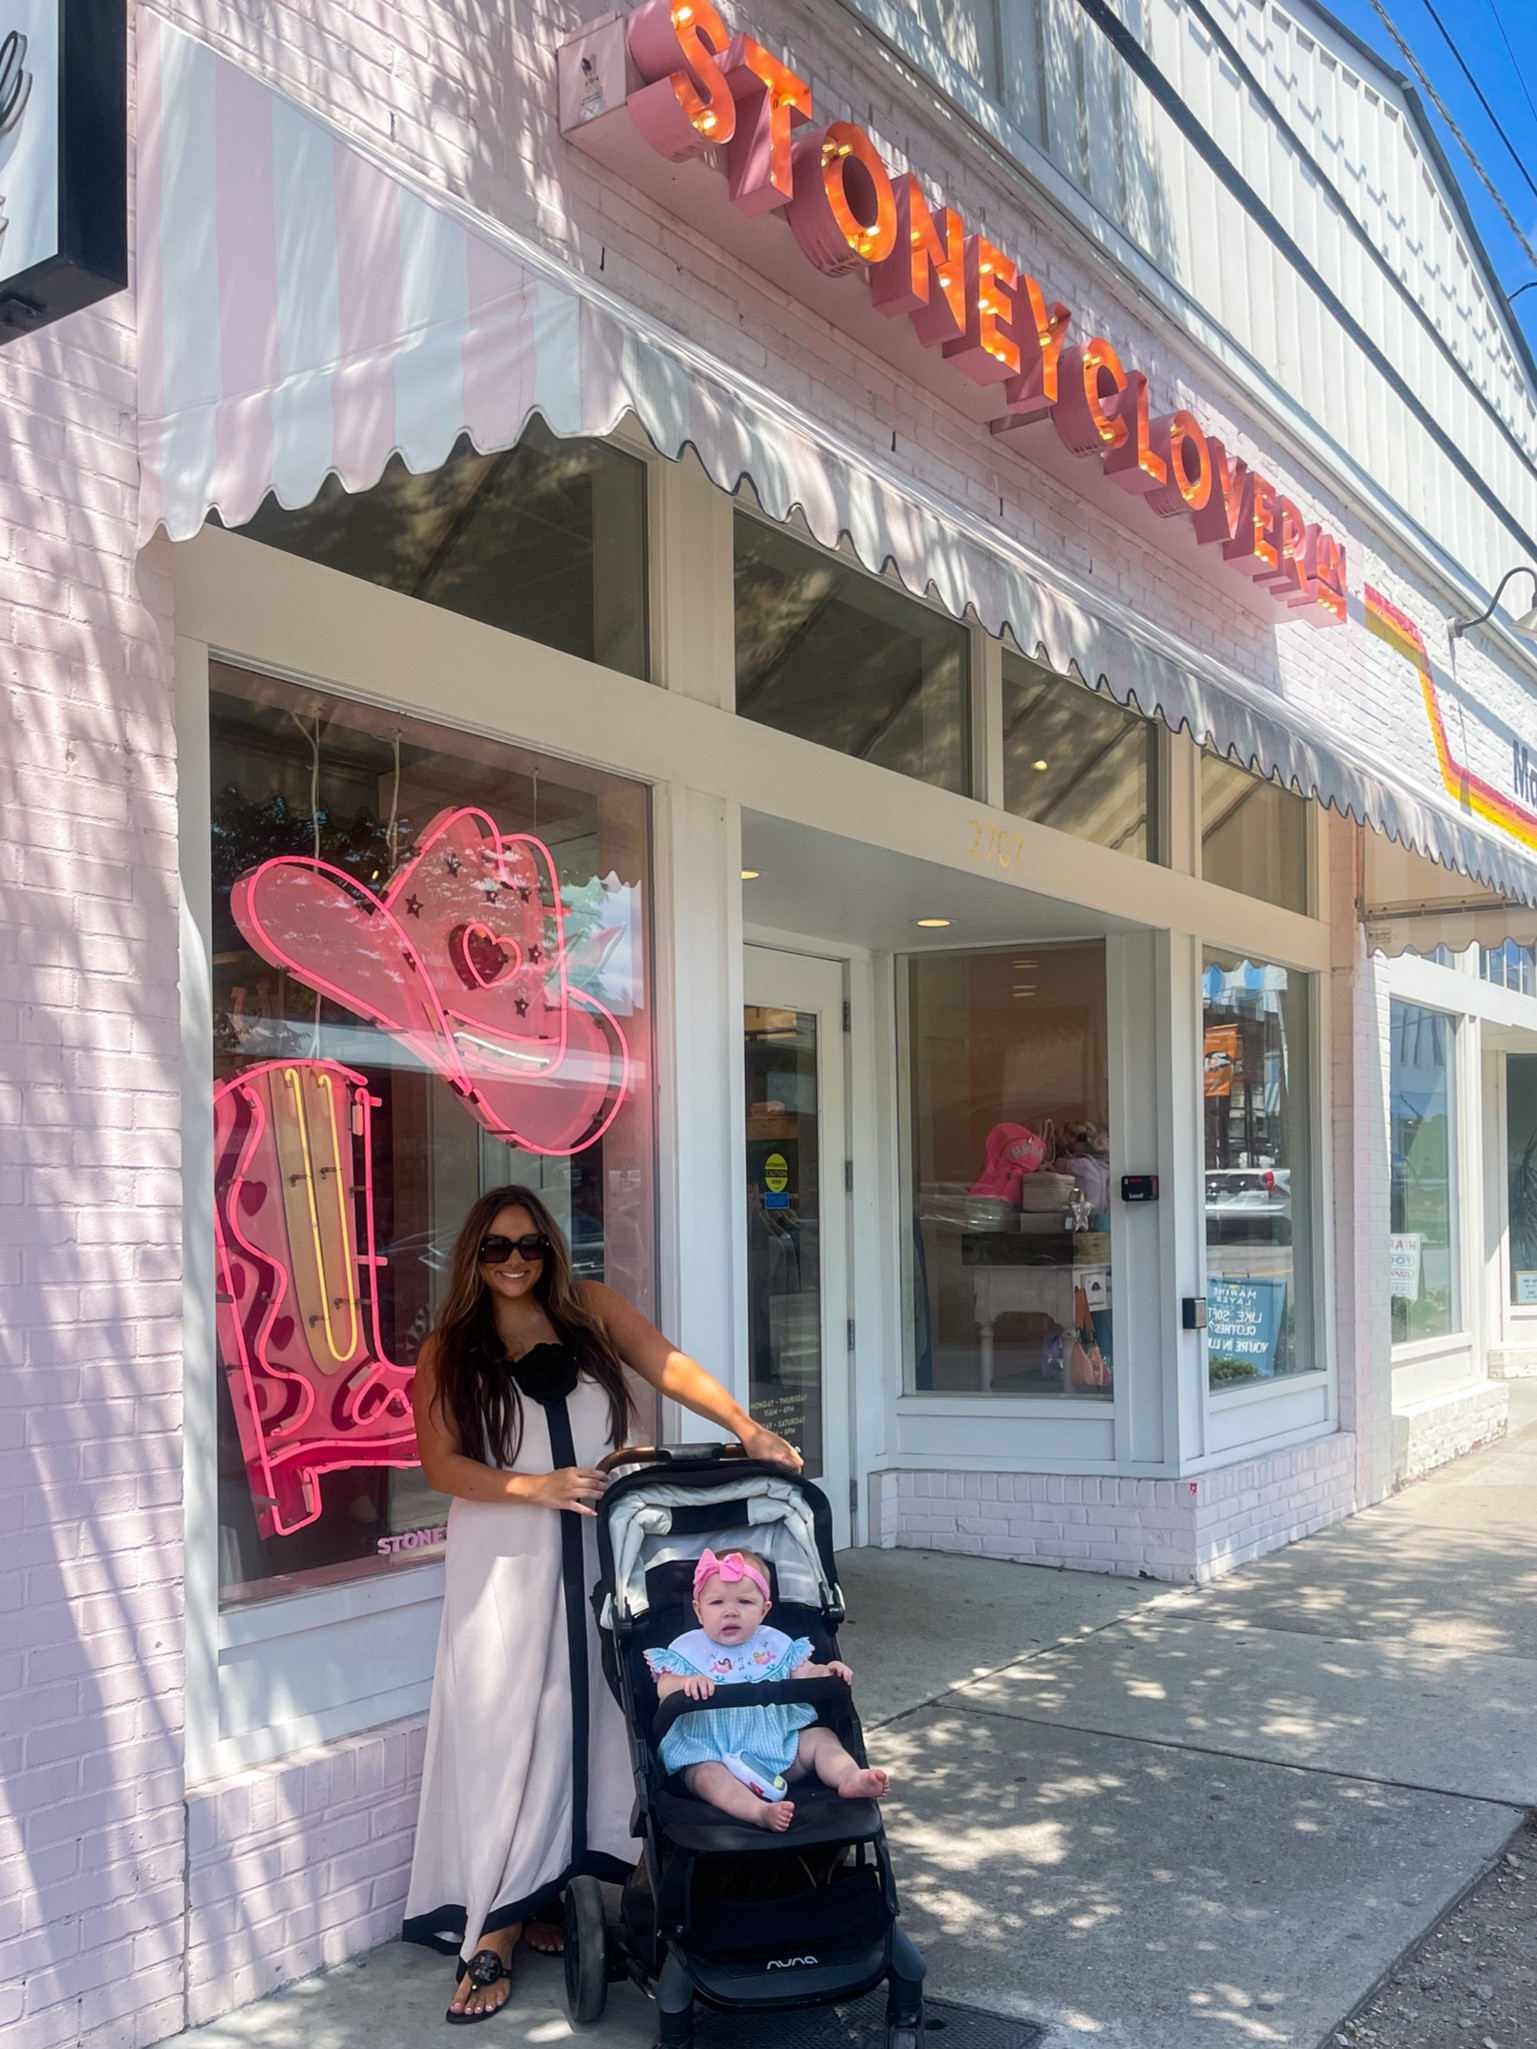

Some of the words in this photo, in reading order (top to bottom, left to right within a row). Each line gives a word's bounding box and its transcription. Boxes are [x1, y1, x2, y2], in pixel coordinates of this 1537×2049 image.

[969, 819, 1023, 868] 2707
[750, 1399, 774, 1409] MONDAY
[779, 1394, 808, 1404] THURSDAY
[778, 1416, 806, 1428] SATURDAY
[766, 1955, 818, 1970] nuna
